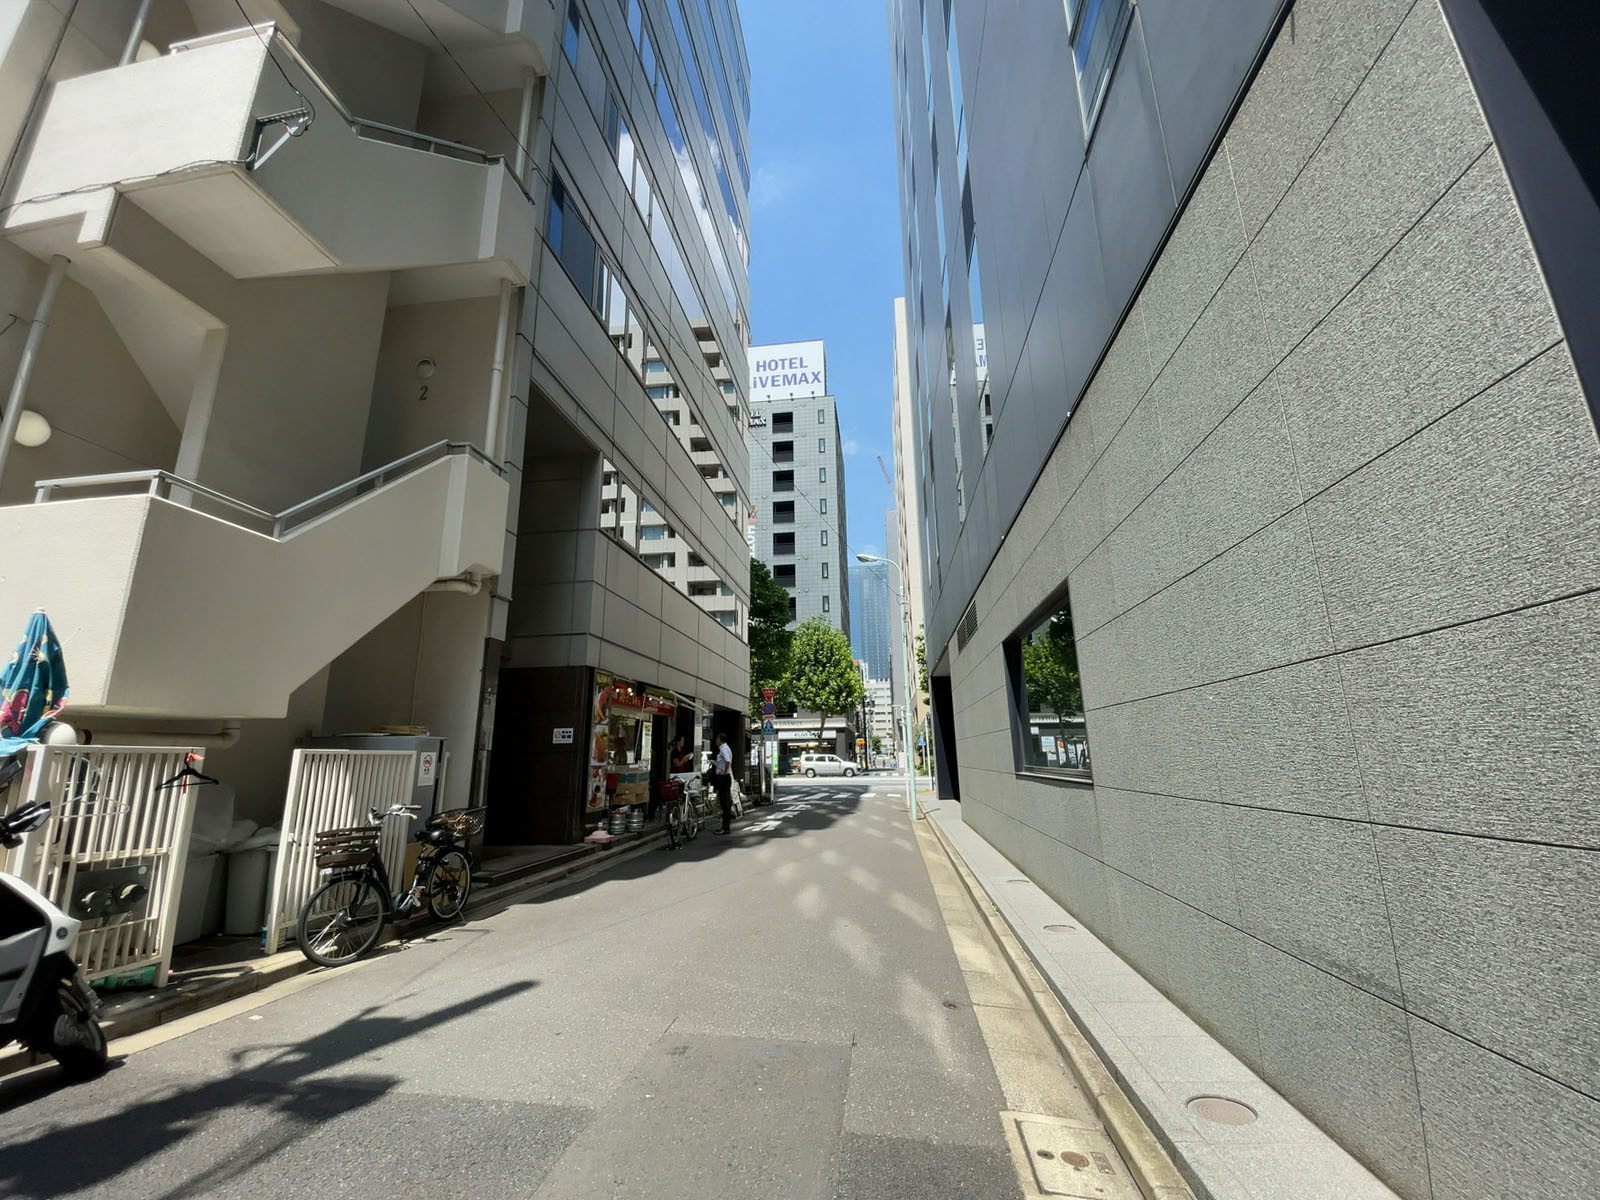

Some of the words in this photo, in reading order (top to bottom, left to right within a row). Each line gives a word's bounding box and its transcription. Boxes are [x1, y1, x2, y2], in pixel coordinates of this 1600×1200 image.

[756, 357, 808, 372] HOTEL
[750, 371, 821, 389] iVEMAX
[419, 385, 428, 400] 2
